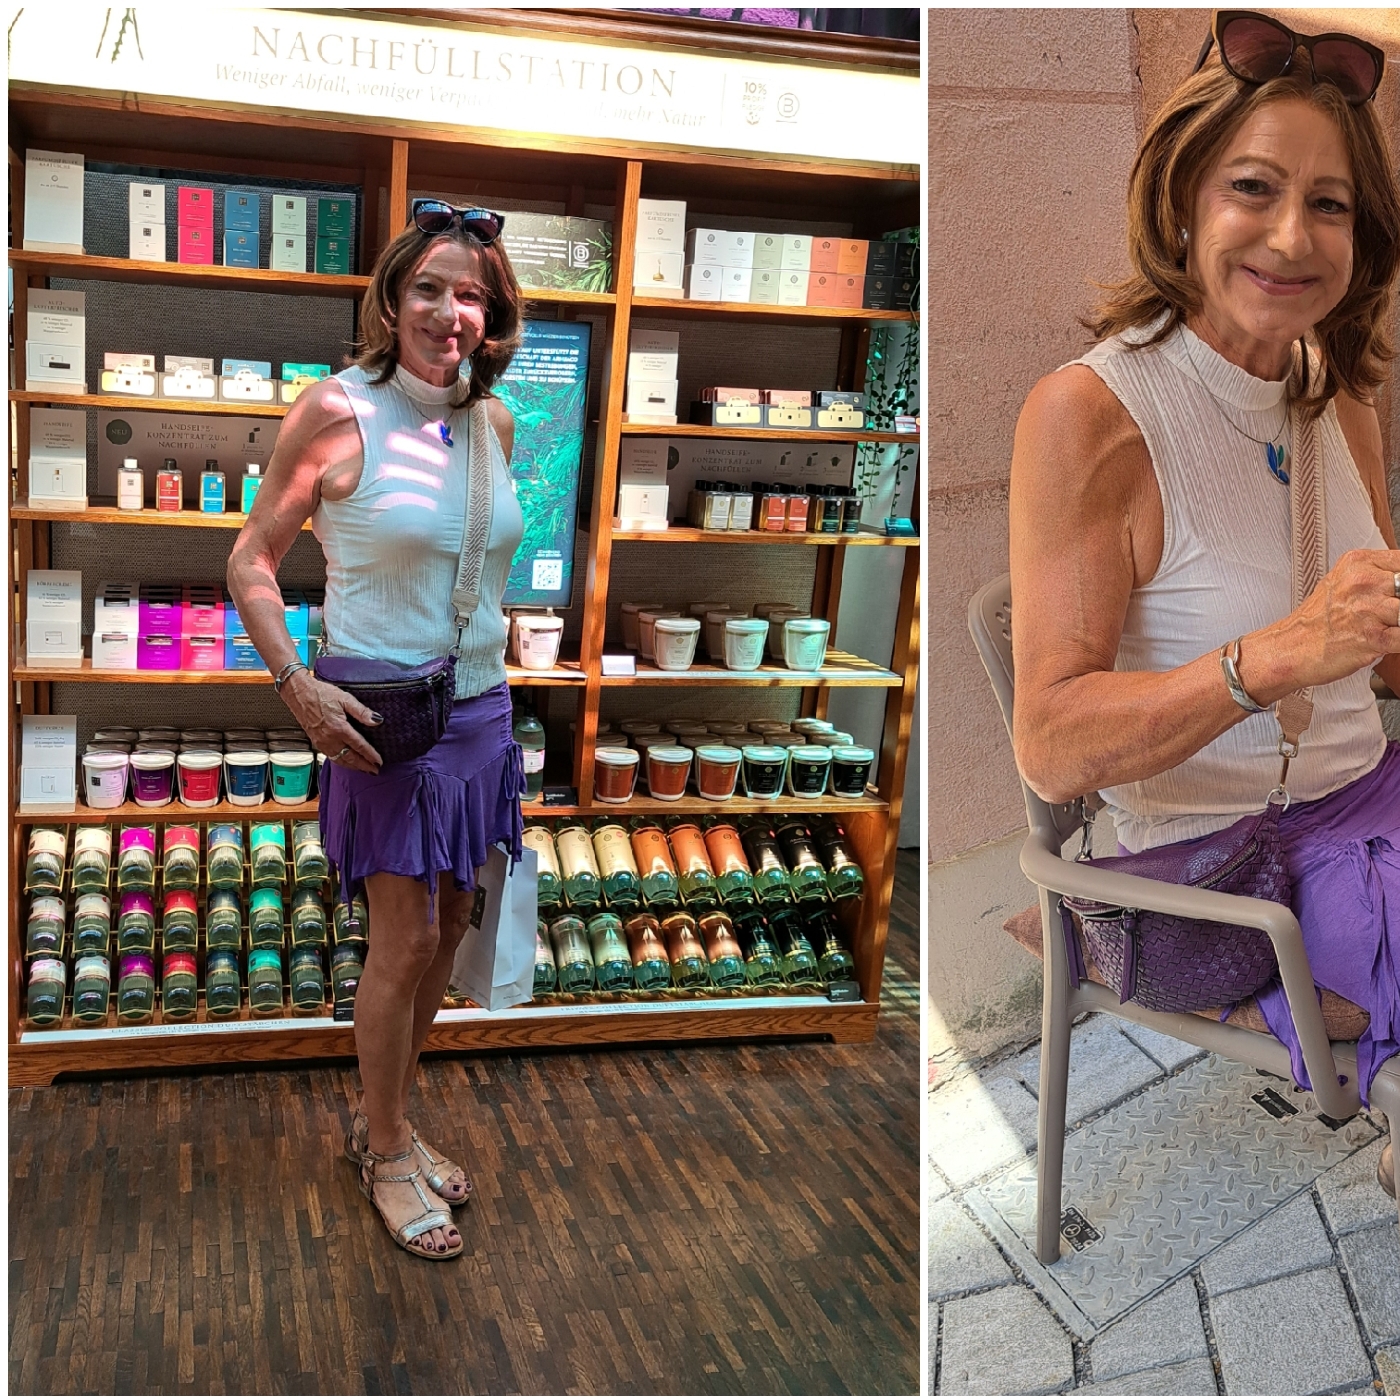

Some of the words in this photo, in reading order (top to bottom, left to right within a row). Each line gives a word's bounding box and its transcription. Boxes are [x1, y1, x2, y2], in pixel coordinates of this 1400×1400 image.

[252, 26, 676, 98] NACHFÜLLSTATION
[215, 63, 288, 90] Weniger
[292, 72, 350, 96] Abfall,
[357, 82, 423, 103] weniger
[744, 81, 767, 96] 10%
[208, 433, 228, 442] ZUM
